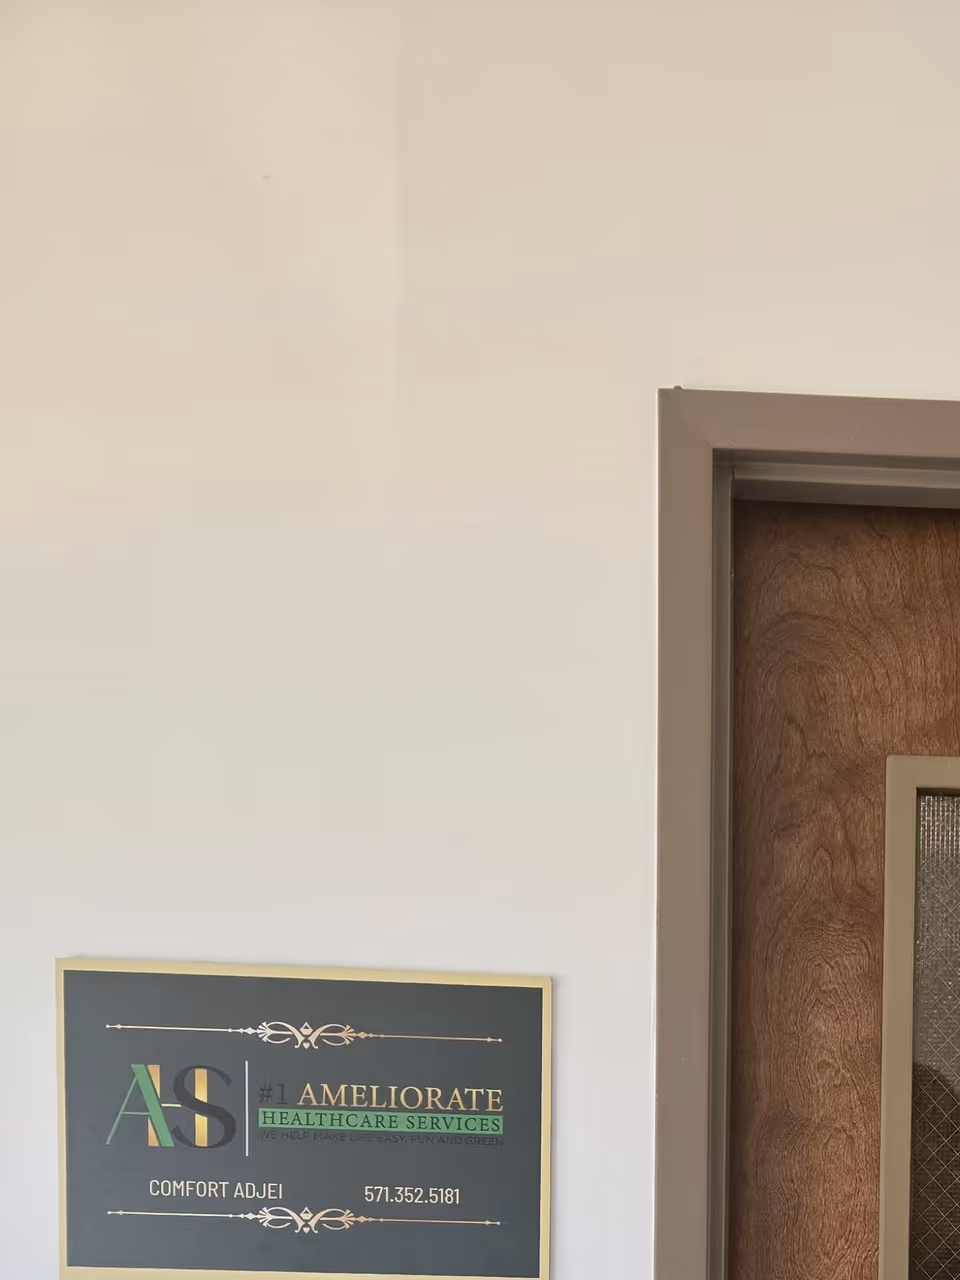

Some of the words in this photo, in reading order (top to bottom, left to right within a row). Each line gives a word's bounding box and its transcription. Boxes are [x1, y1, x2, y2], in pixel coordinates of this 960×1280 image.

[259, 1083, 289, 1105] #1
[297, 1082, 504, 1112] AMELIORATE
[262, 1110, 399, 1129] HEALTHCARE
[406, 1115, 501, 1132] SERVICES
[465, 1136, 503, 1146] GREEN
[149, 1179, 229, 1198] COMFORT
[233, 1181, 284, 1200] ADJEI
[364, 1185, 461, 1205] 571.352.5181
